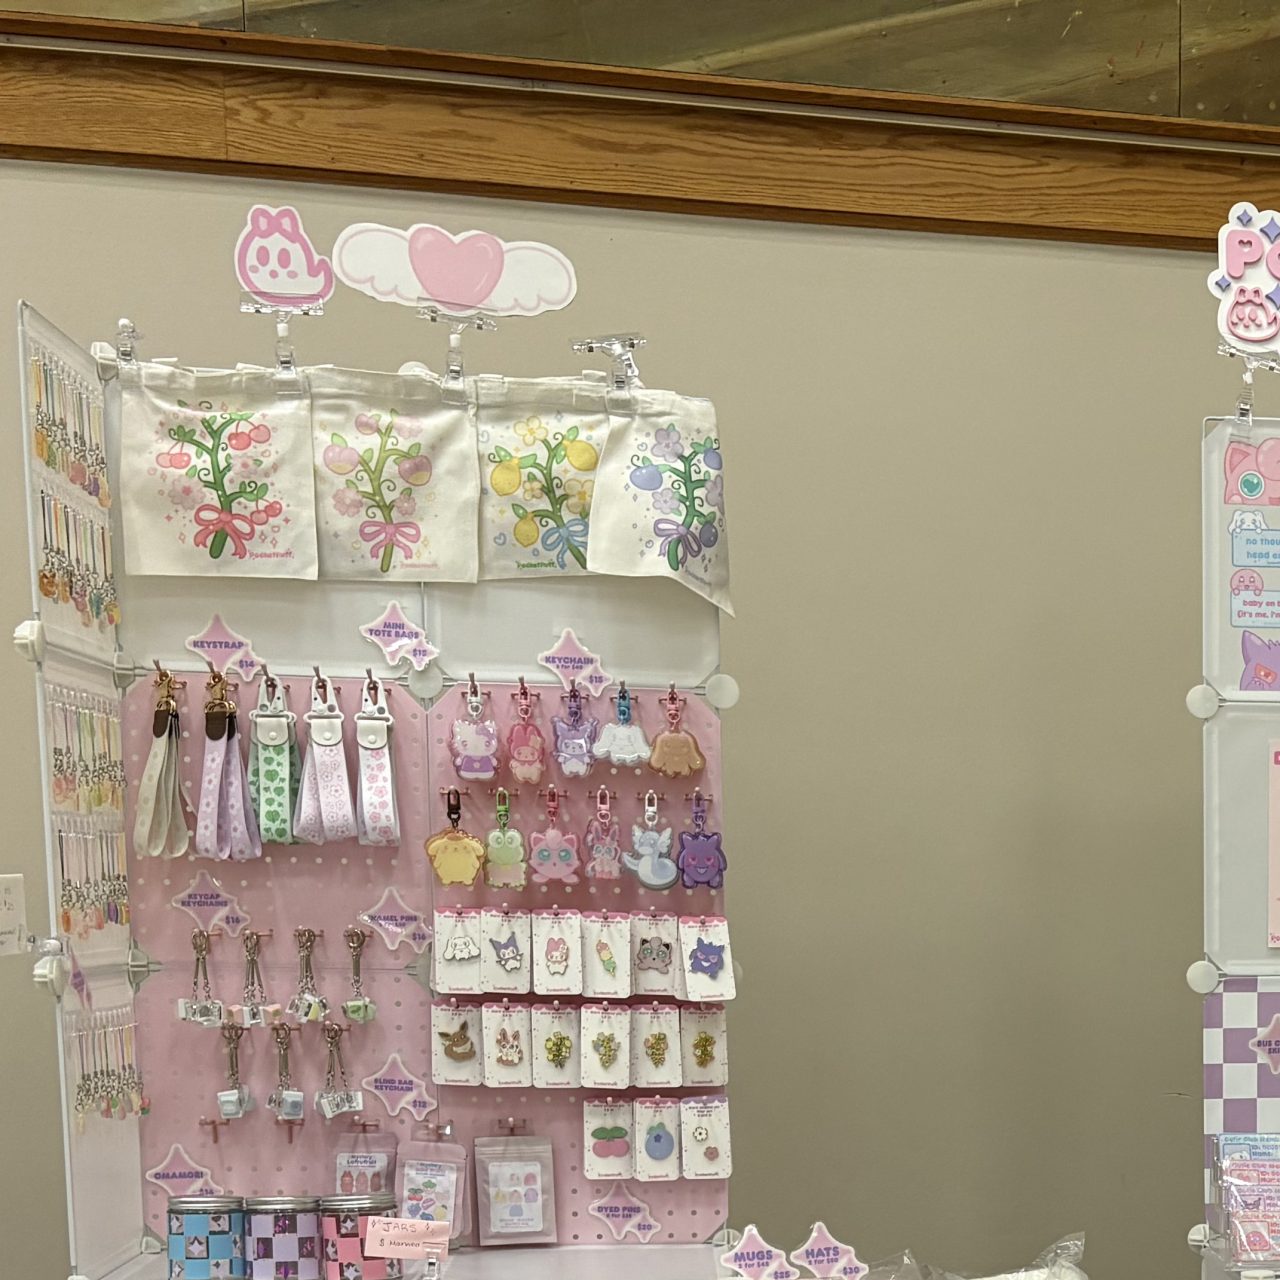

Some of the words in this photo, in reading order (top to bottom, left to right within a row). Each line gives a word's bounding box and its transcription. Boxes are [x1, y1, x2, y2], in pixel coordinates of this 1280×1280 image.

[1246, 538, 1257, 546] no
[1246, 551, 1270, 560] head
[1242, 600, 1263, 609] baby
[383, 622, 405, 630] MINI
[369, 629, 393, 638] TOTE
[394, 631, 420, 639] BAGS
[193, 640, 244, 649] KEYSTRAP
[545, 655, 594, 665] KEYCHAIN
[181, 900, 228, 908] KEYCHAINS
[1257, 1039, 1273, 1048] BUS
[373, 1078, 397, 1086] BLIND
[154, 1171, 203, 1180] OMAMORI
[622, 1206, 641, 1214] PINS
[382, 1221, 417, 1233] JARS
[733, 1250, 773, 1263] MUGS
[805, 1246, 840, 1259] HATS
[843, 1266, 860, 1276] $30
